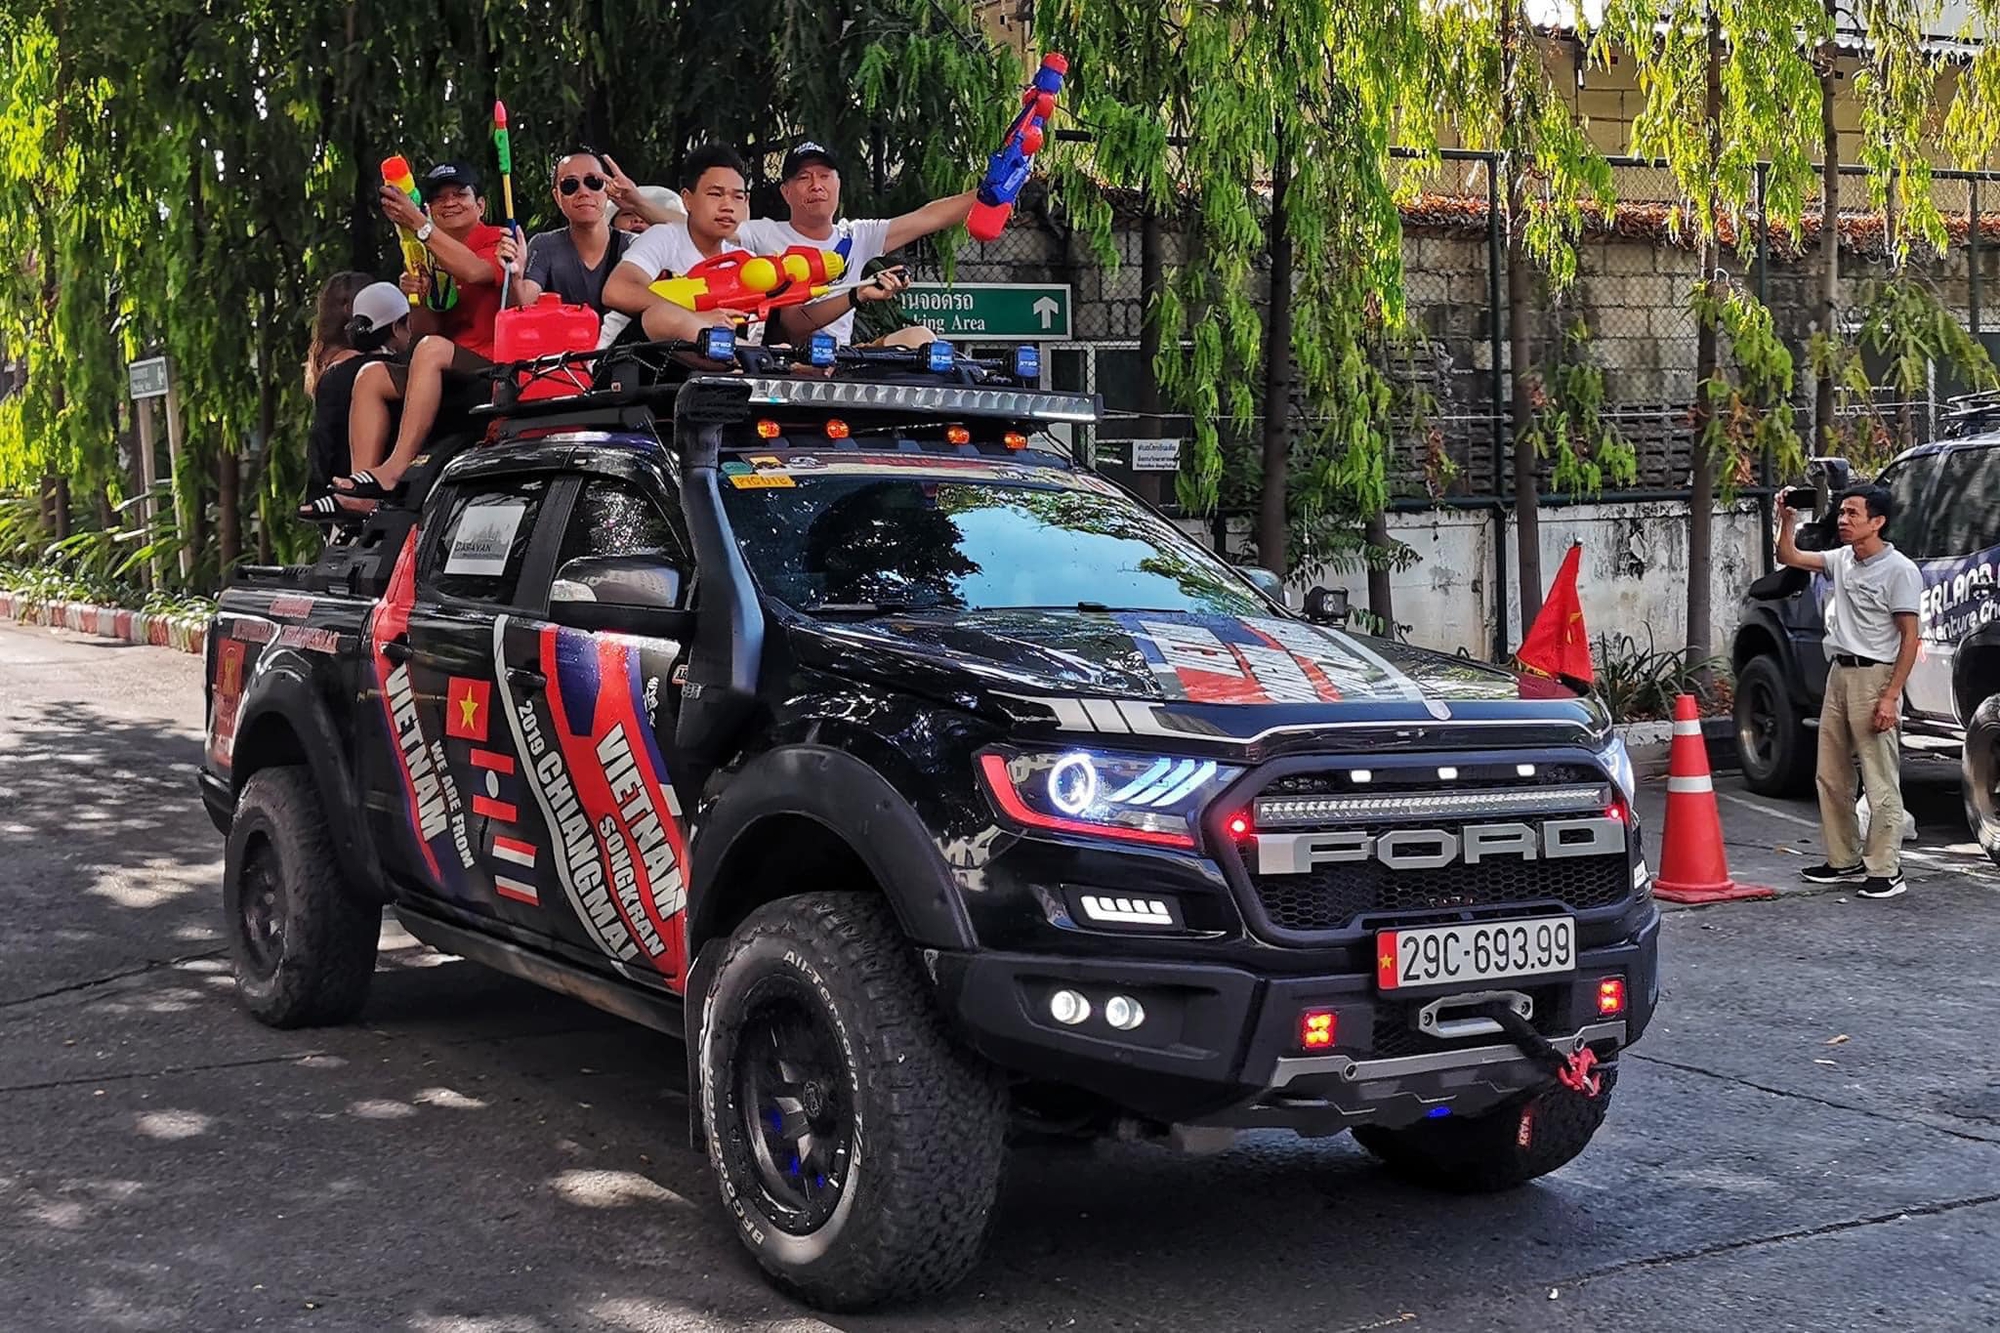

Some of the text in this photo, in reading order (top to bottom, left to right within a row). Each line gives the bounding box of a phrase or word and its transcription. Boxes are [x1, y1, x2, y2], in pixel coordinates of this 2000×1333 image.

[900, 293, 974, 310] านจอดรถ
[902, 314, 986, 334] king Area
[385, 662, 448, 842] VIETNAM
[430, 739, 475, 869] WE ARE FROM
[518, 700, 640, 962] 2019 CHIANGMAI
[596, 722, 688, 922] VIETNAM
[599, 815, 668, 958] SONGKRAN
[1259, 818, 1626, 875] FORD
[1402, 922, 1570, 982] 29C-693.99
